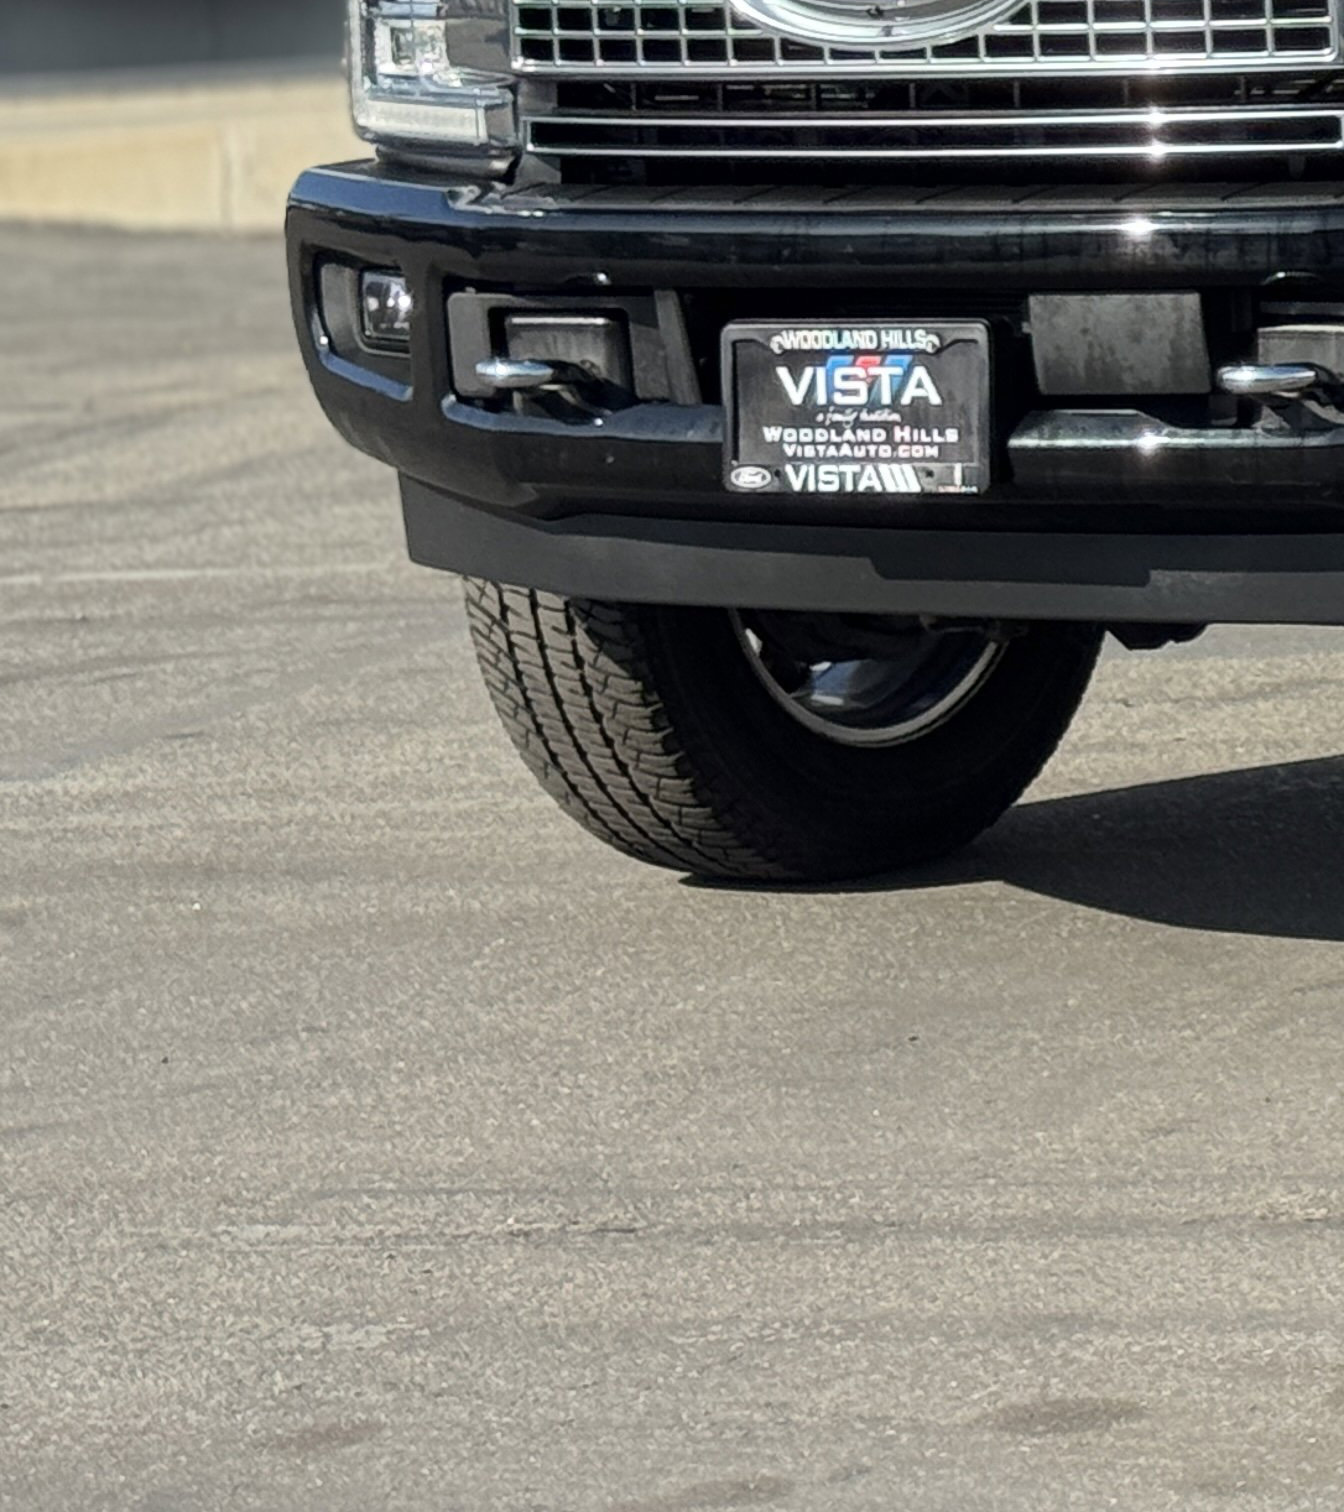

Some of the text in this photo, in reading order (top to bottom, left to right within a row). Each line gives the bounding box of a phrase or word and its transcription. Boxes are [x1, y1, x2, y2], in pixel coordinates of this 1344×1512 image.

[782, 328, 928, 352] WOODLAND HILLS
[776, 365, 943, 406] VISTA
[785, 464, 882, 493] VISTA
